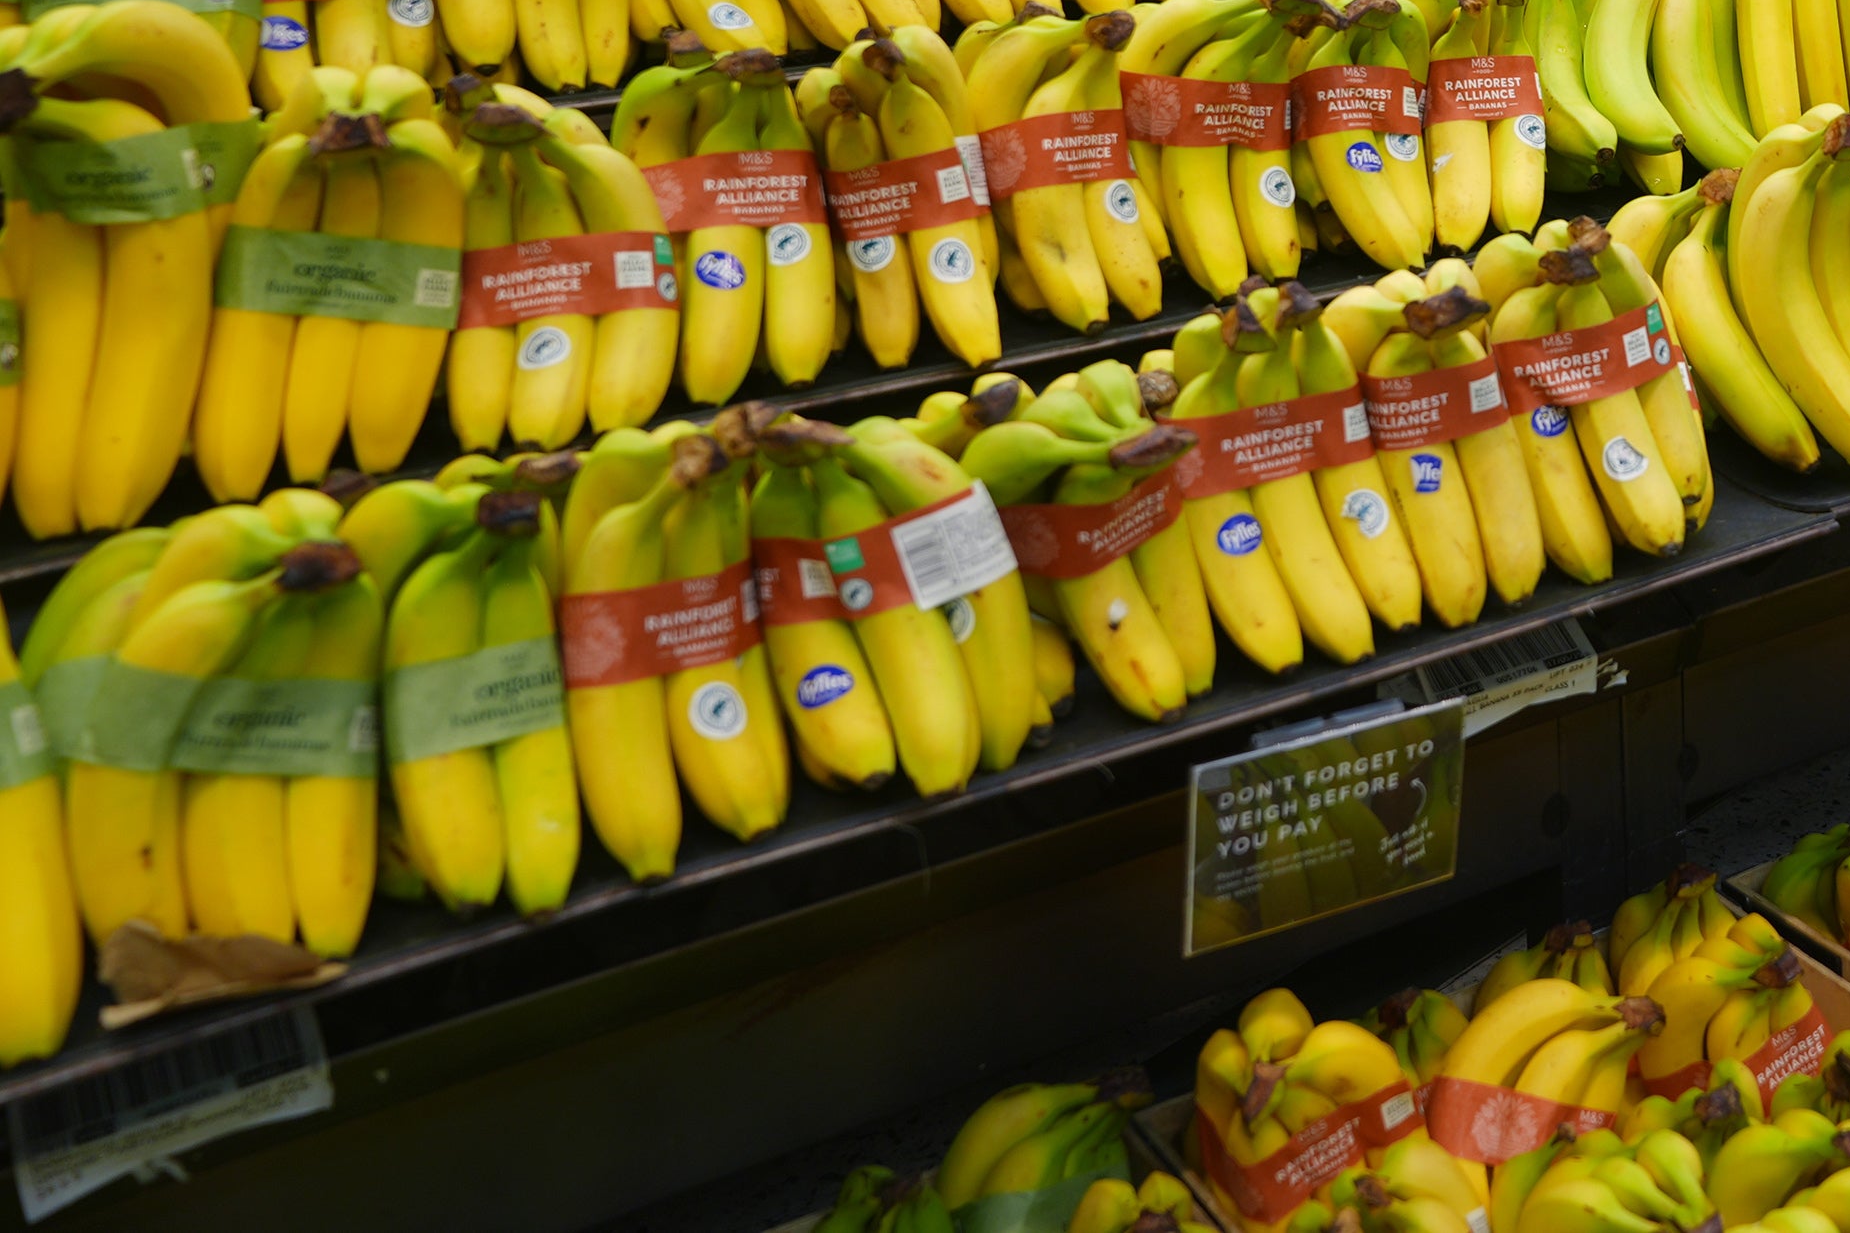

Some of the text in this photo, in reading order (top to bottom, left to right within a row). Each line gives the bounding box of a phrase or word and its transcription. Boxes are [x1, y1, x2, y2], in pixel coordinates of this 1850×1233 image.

[1472, 57, 1495, 68] M&S
[1343, 66, 1367, 78] M&S
[1445, 77, 1521, 91] RAINFOREST
[1317, 88, 1392, 102] RAINFOREST
[1455, 89, 1516, 101] ALLIANCE
[1195, 103, 1273, 117] RAINFOREST
[1328, 100, 1385, 112] ALLIANCE
[1469, 101, 1507, 110] BANANAS
[1204, 115, 1265, 130] ALLIANCE
[1042, 134, 1119, 150] RAINFOREST
[1054, 147, 1112, 162] ALLIANCE
[703, 176, 807, 191] RAINFOREST
[716, 190, 799, 203] ALLIANCE
[830, 182, 918, 206] RAINFOREST
[839, 198, 911, 217] ALLIANCE
[482, 261, 592, 288] RAINFOREST
[495, 278, 582, 301] ALLIANCE
[1542, 333, 1573, 349] M&S
[1513, 349, 1610, 378] RAINFOREST
[1379, 377, 1412, 391] M&S
[1528, 365, 1603, 388] ALLIANCE
[1221, 421, 1324, 453] RAINFOREST
[1234, 437, 1313, 465] ALLIANCE
[1218, 739, 1434, 810] DON'T FORGET TO
[1219, 772, 1399, 835] WEIGH BEFORE
[1217, 816, 1323, 859] YOU PAY
[1756, 1024, 1827, 1084] RAINFOREST
[1767, 1042, 1825, 1090] ALLIANCE
[1580, 1110, 1605, 1124] M&S
[1274, 1115, 1360, 1182] RAINFOREST
